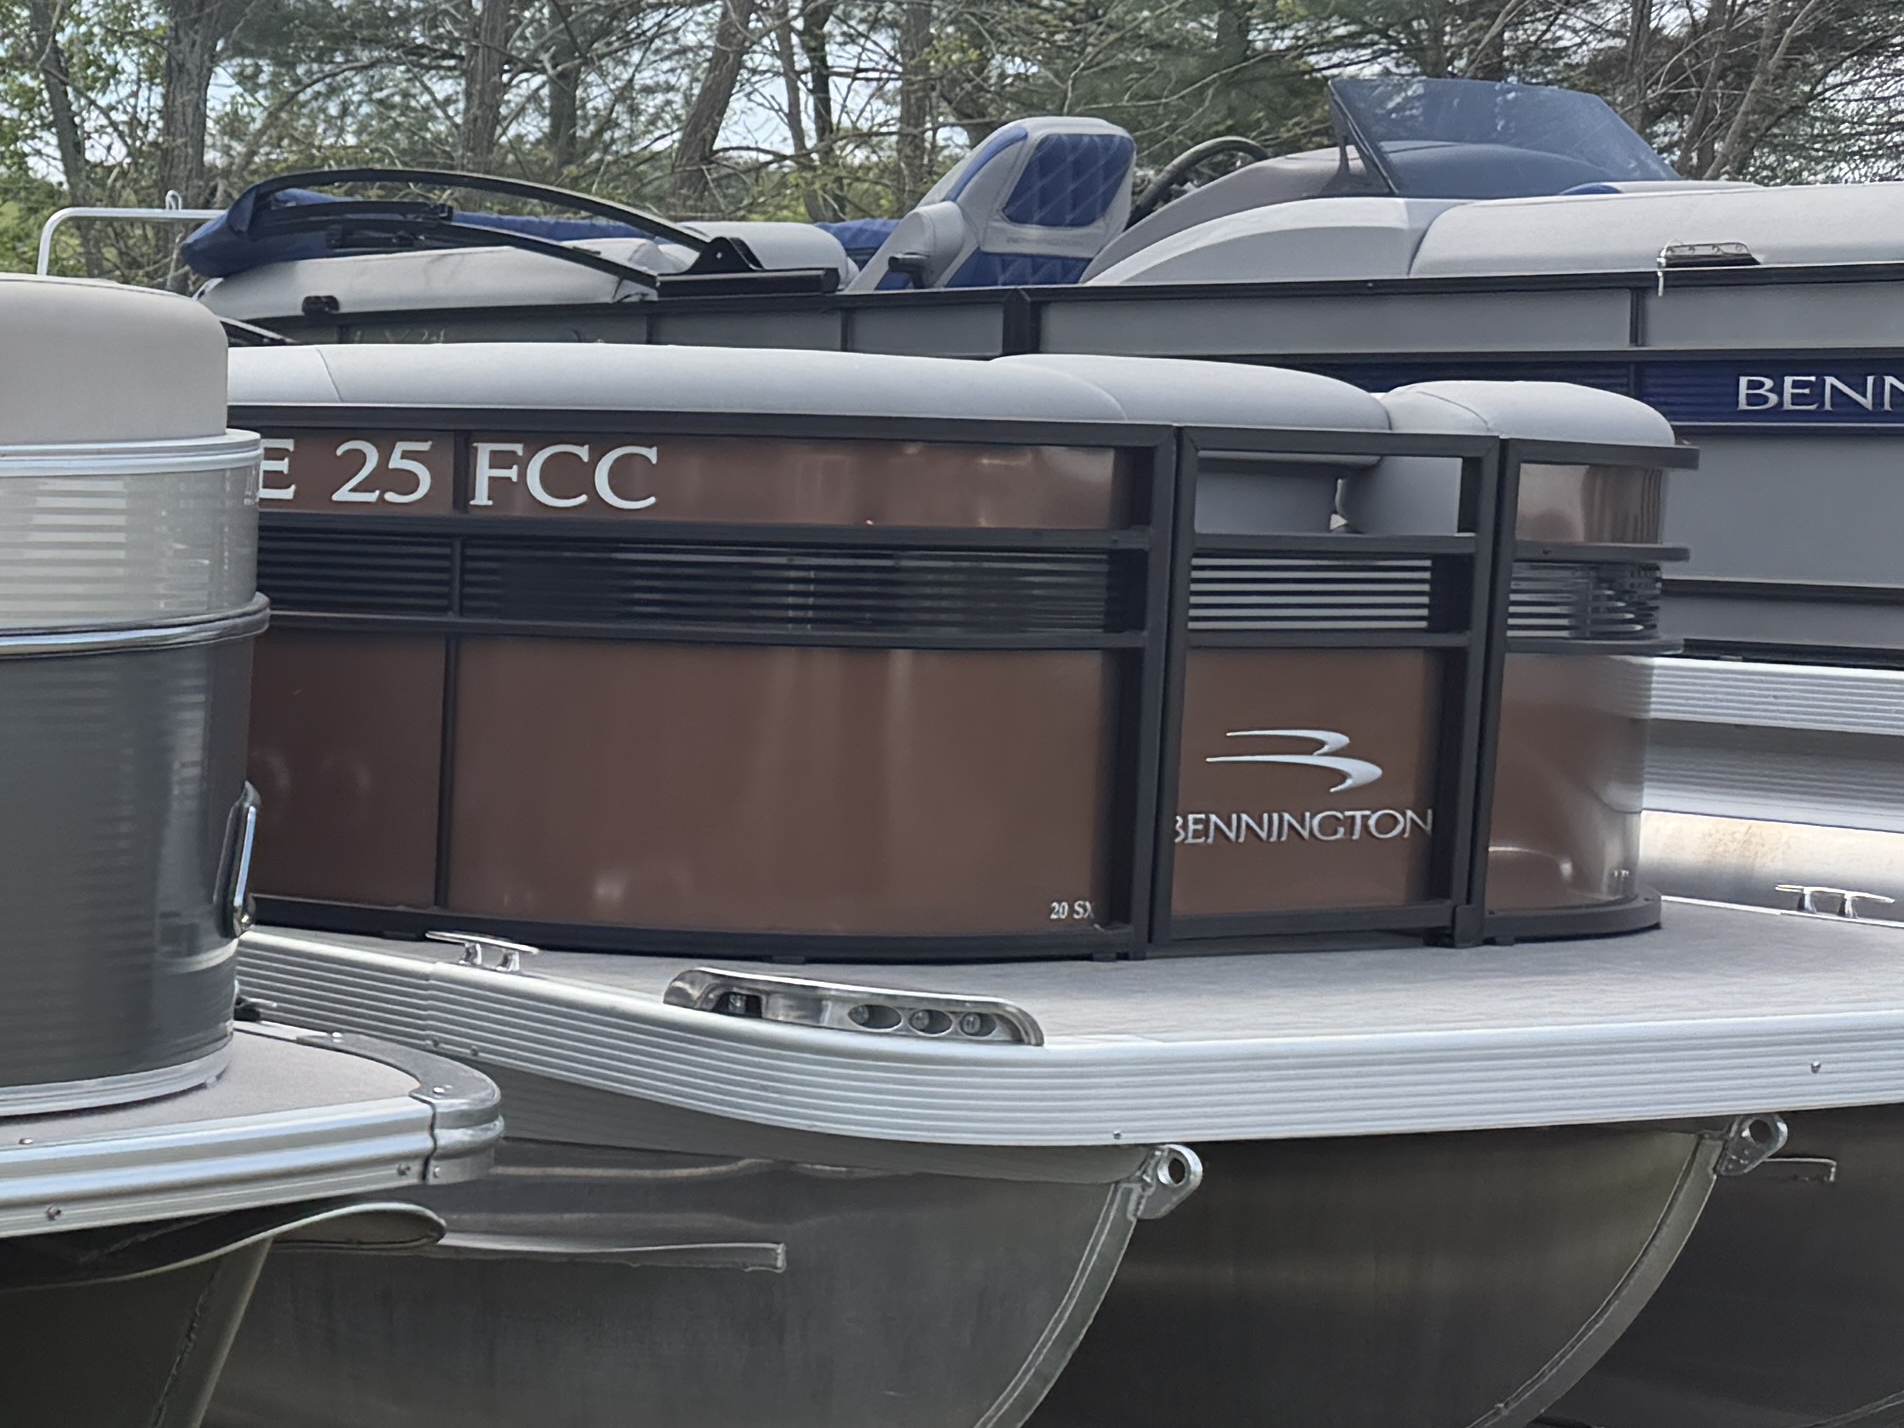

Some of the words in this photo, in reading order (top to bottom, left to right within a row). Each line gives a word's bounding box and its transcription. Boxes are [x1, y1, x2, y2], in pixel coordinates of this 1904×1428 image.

[330, 439, 434, 505] 25
[468, 442, 659, 510] FCC
[1050, 901, 1069, 919] 20
